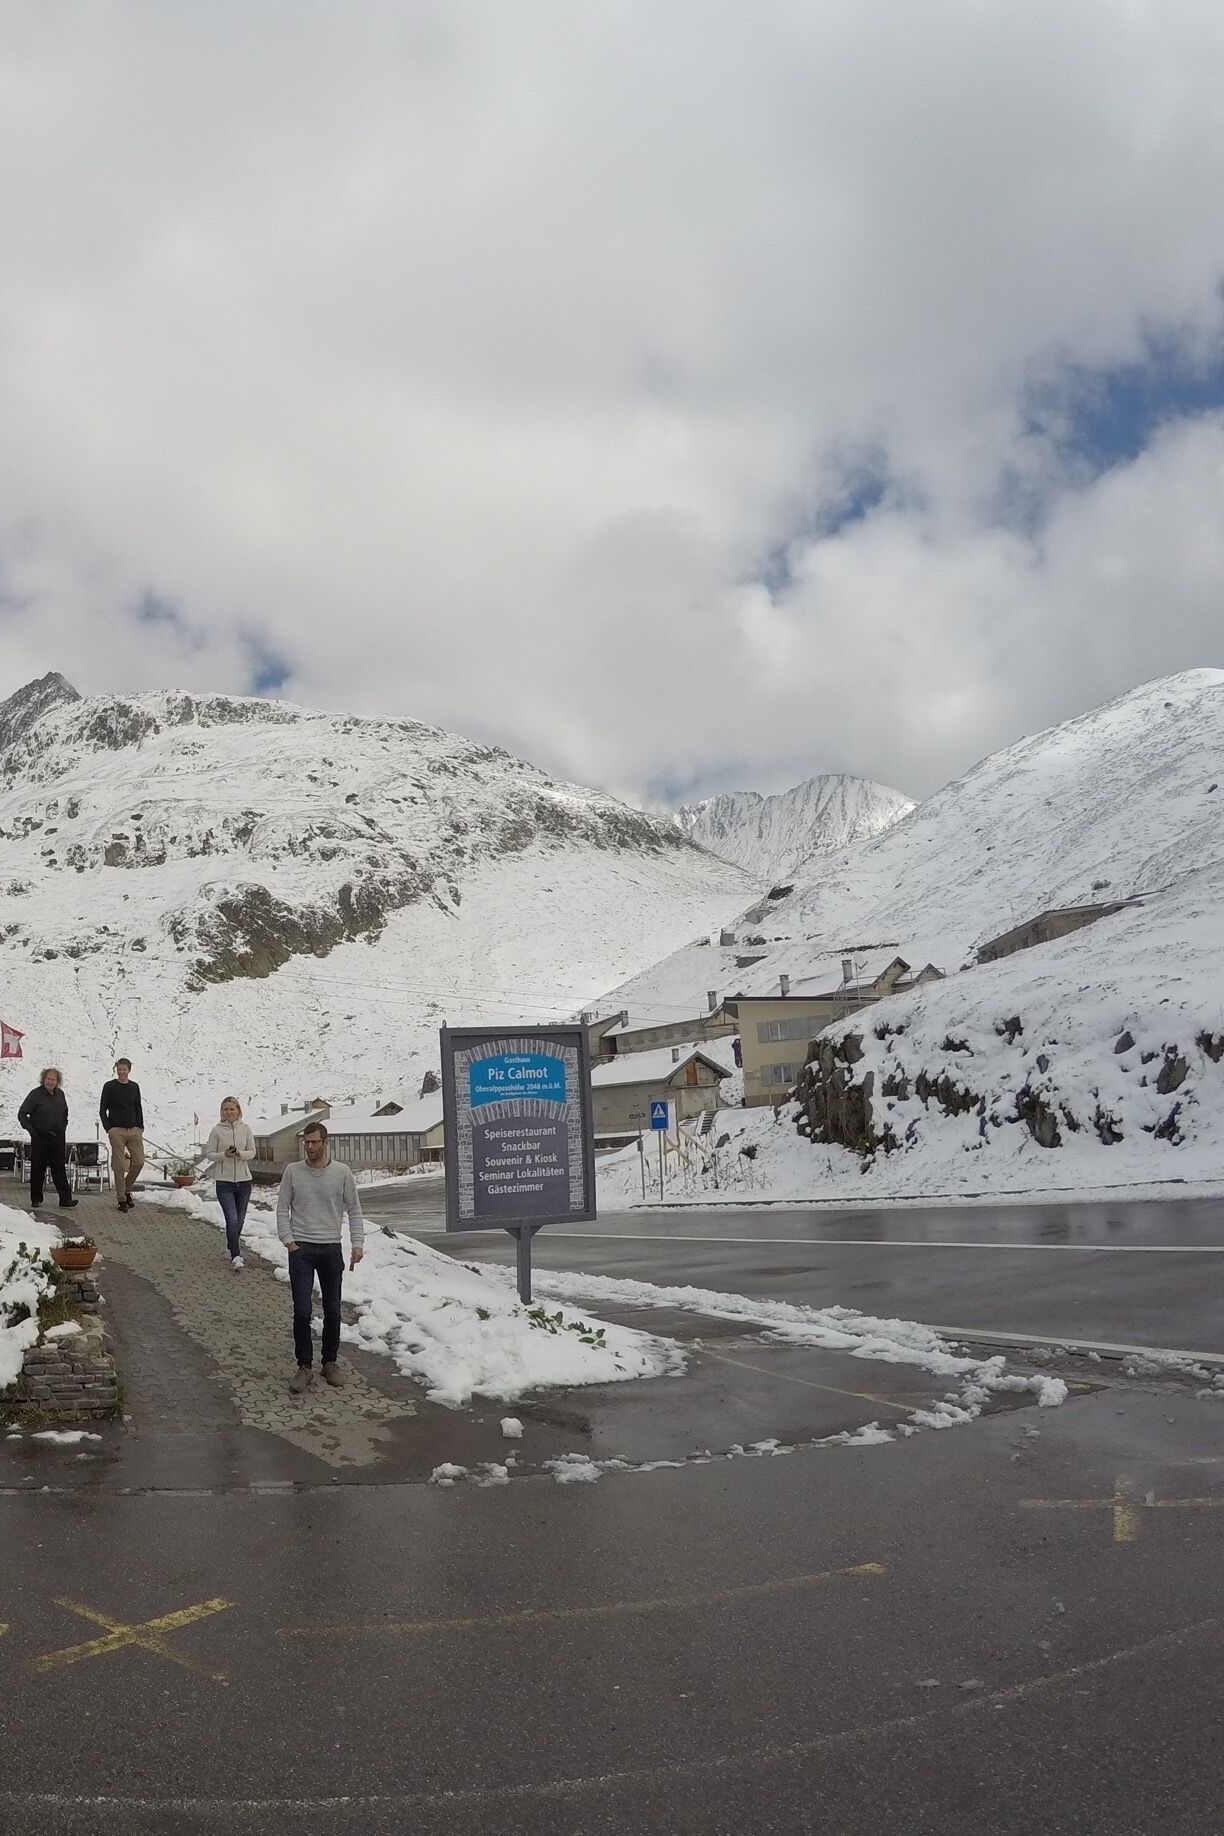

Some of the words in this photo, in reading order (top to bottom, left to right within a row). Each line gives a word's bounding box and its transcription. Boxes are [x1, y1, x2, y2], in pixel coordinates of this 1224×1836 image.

[504, 1056, 531, 1064] Gasthaus
[488, 1068, 505, 1080] Piz
[507, 1066, 548, 1080] Calmot
[484, 1126, 556, 1141] Speiserestaurant
[501, 1140, 541, 1152] Snackbar
[485, 1155, 523, 1167] Souvenir
[525, 1154, 532, 1164] &
[534, 1152, 558, 1164] Kiosk
[478, 1170, 514, 1181] Seminar
[516, 1167, 565, 1179] Lokalitäten
[487, 1182, 544, 1195] Gästezimmer
